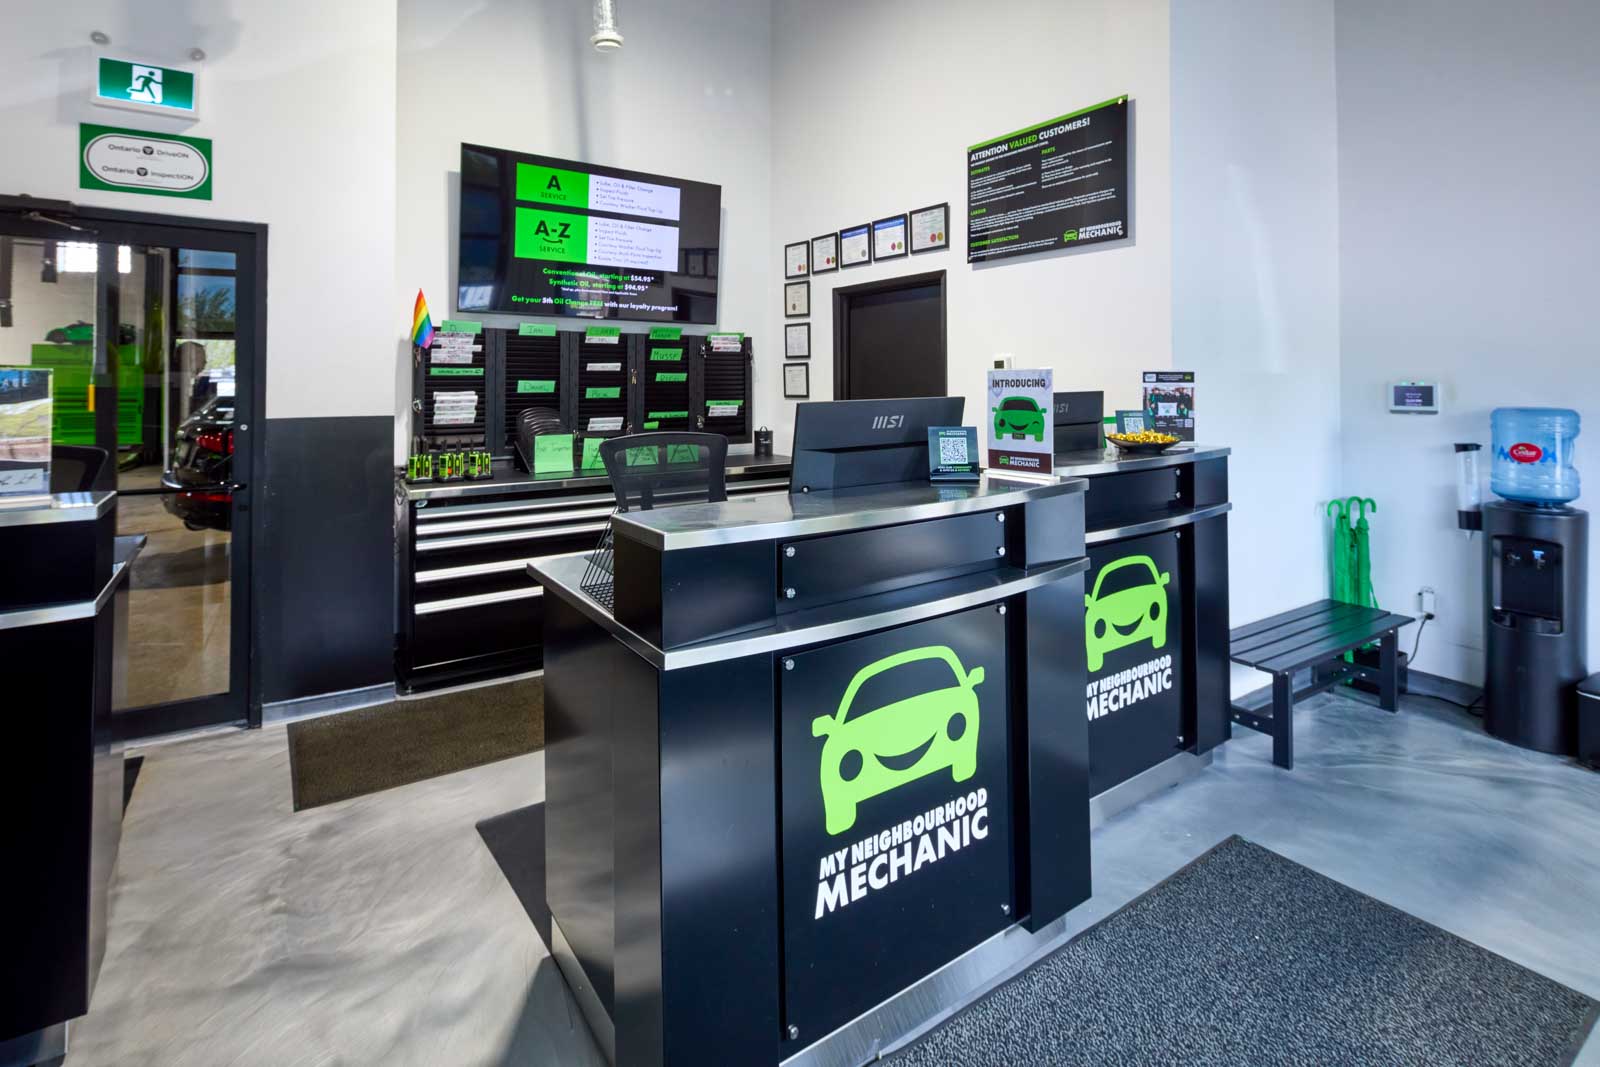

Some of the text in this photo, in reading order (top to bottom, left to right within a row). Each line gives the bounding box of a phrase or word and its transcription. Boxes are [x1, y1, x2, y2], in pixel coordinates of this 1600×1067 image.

[970, 144, 1008, 161] ATTENTION
[1009, 135, 1037, 149] VALUED
[1039, 117, 1090, 140] CUSTOMERS!
[108, 144, 140, 153] Ontario
[102, 165, 134, 174] Ontario
[547, 175, 561, 191] A
[541, 192, 566, 200] SERVICE
[535, 220, 570, 238] A-Z
[1078, 226, 1123, 240] MECHANIC
[540, 245, 565, 254] SERVICE
[542, 267, 586, 277] Conventional
[599, 272, 622, 282] starting
[549, 278, 578, 286] Synthetic
[592, 282, 616, 290] starting
[630, 302, 650, 311] loyalty
[651, 304, 678, 312] program!
[992, 378, 1046, 388] INTRODUCING
[872, 415, 904, 429] MSI
[1100, 654, 1171, 693] NEIGHBOURHOOD
[1086, 668, 1172, 721] MECHANIC
[819, 787, 988, 880] MY NEIGHBOURHOOD
[815, 807, 988, 920] MECHANIC
